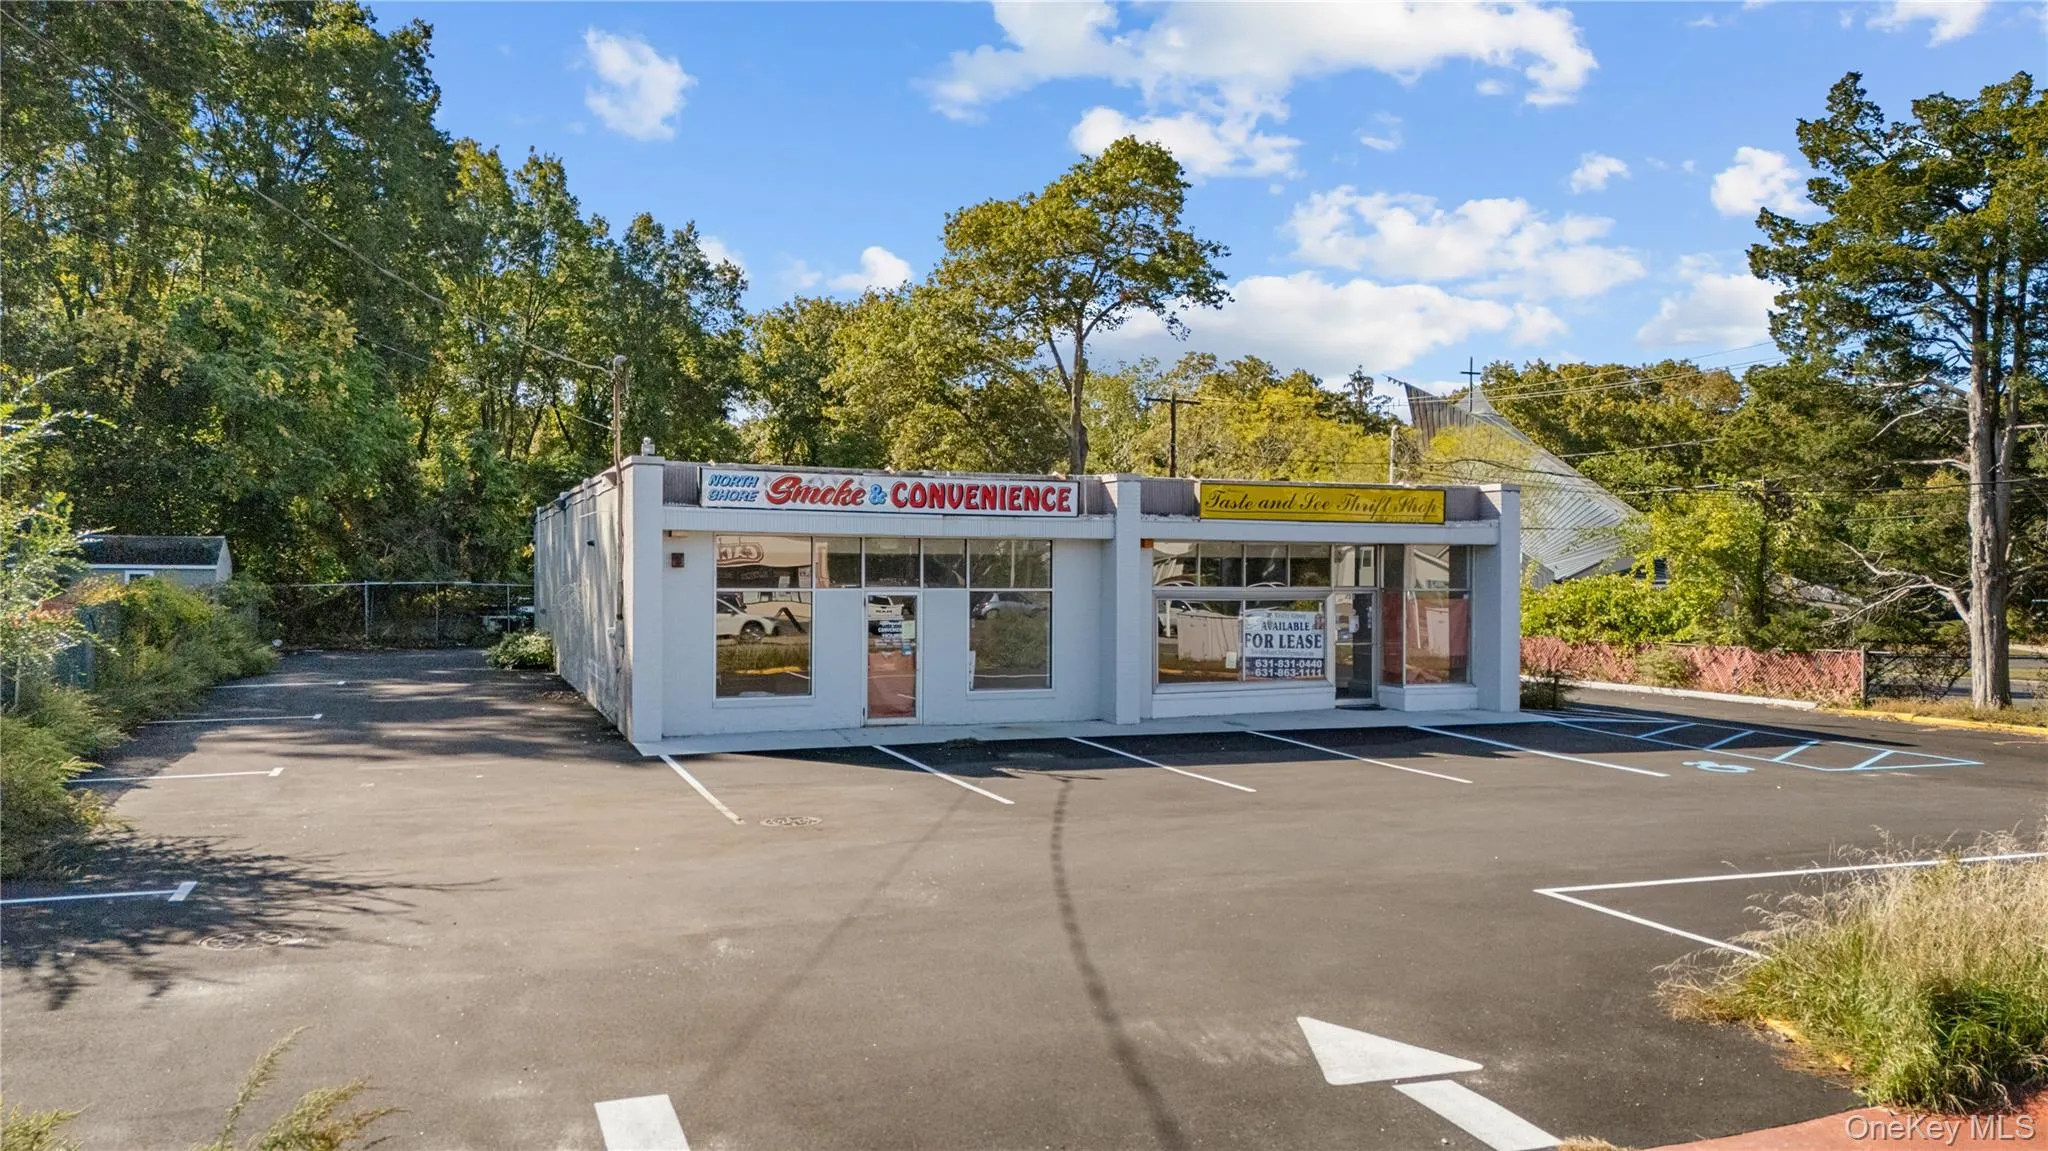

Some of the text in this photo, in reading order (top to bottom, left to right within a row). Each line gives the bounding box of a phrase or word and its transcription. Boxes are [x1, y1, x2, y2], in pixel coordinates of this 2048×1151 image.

[708, 474, 759, 488] NORTH
[708, 489, 759, 502] SHORE
[765, 474, 1072, 512] Smoke & CONVENIENCE
[1205, 489, 1253, 509] Taste
[1258, 493, 1297, 510] and
[1300, 492, 1330, 511] See
[1337, 493, 1392, 520] Thrift
[1394, 495, 1437, 520] Shop
[1261, 621, 1310, 631] AVAILABLE
[1245, 633, 1322, 649] FOR LEASE
[1255, 659, 1323, 668] 631-831-0440
[1255, 668, 1322, 677] 631-863-1111
